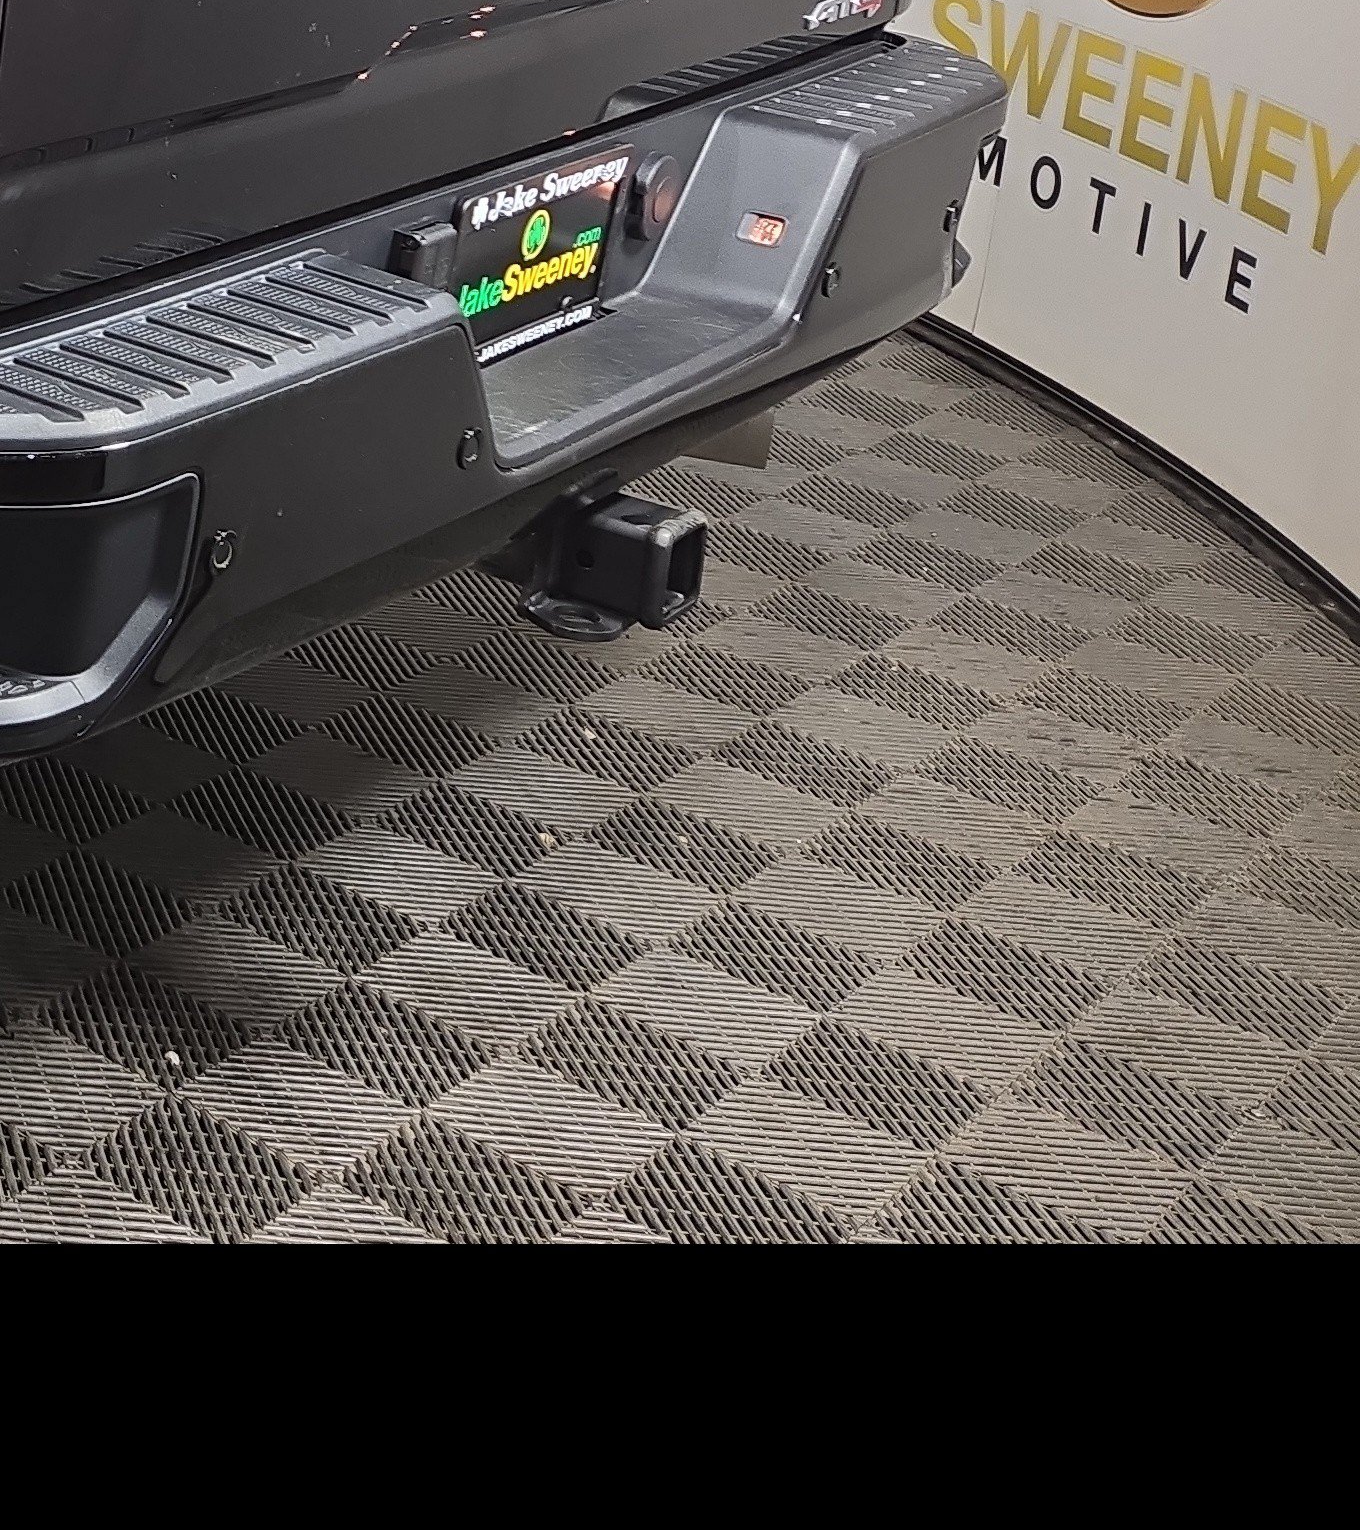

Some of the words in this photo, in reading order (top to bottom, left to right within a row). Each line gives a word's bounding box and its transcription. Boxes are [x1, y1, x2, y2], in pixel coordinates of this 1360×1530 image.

[488, 185, 538, 221] Jake
[540, 157, 629, 203] Sweeney
[977, 135, 1258, 314] MOTIVE
[477, 306, 593, 363] JAKESWEENEY.COM
